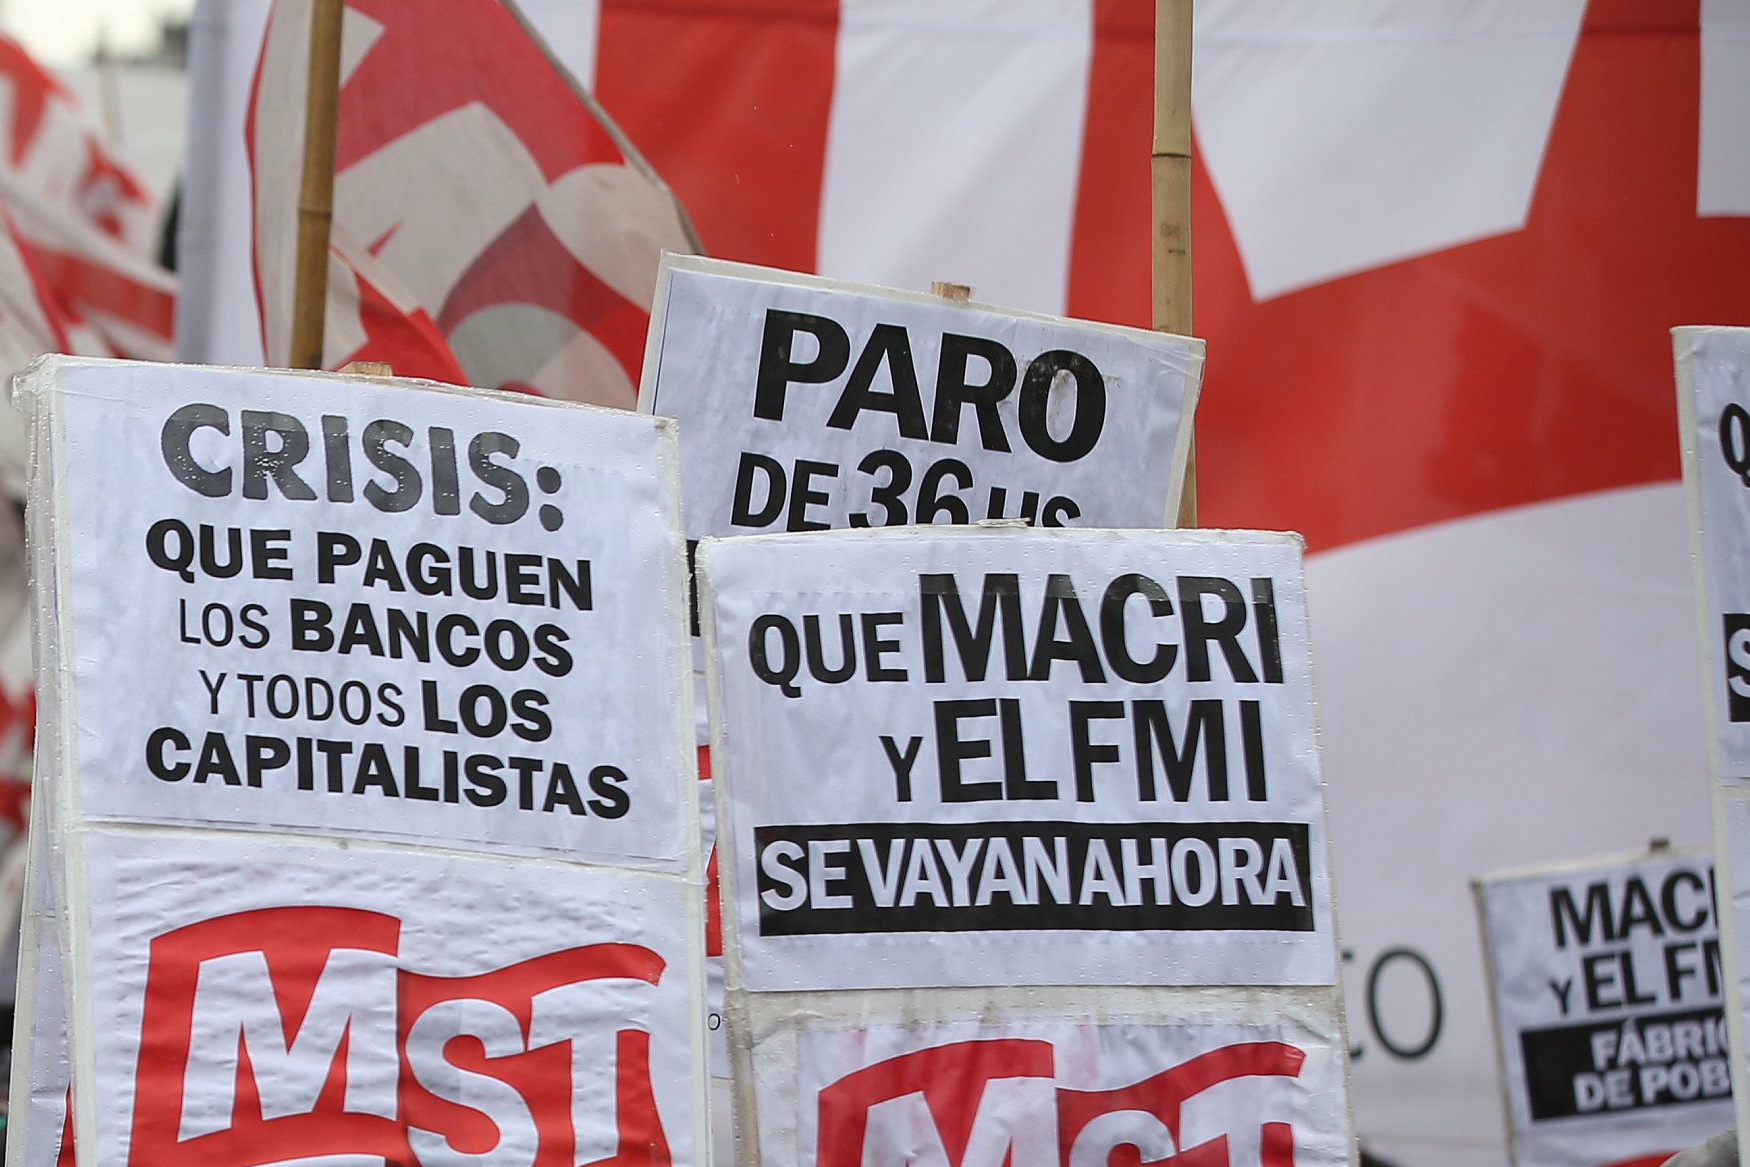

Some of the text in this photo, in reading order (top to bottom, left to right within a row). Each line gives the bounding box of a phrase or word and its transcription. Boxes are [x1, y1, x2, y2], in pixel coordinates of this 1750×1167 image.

[754, 309, 1107, 462] PARO
[160, 402, 564, 533] CRISIS:
[731, 452, 838, 530] DE
[849, 449, 973, 527] 36
[145, 518, 593, 612] QUE PAGUEN
[179, 598, 573, 678] LOS BANCOS
[750, 573, 1284, 698] QUE MACRI
[199, 670, 552, 743] Y TODOS LOS
[145, 726, 632, 820] CAPITALISTAS
[878, 698, 1267, 803] Y EL FMI
[760, 837, 1306, 912] SE VAYAN AHORA
[1550, 974, 1573, 1015] Y
[1580, 948, 1658, 1012] EL
[1572, 1069, 1632, 1112] DE
